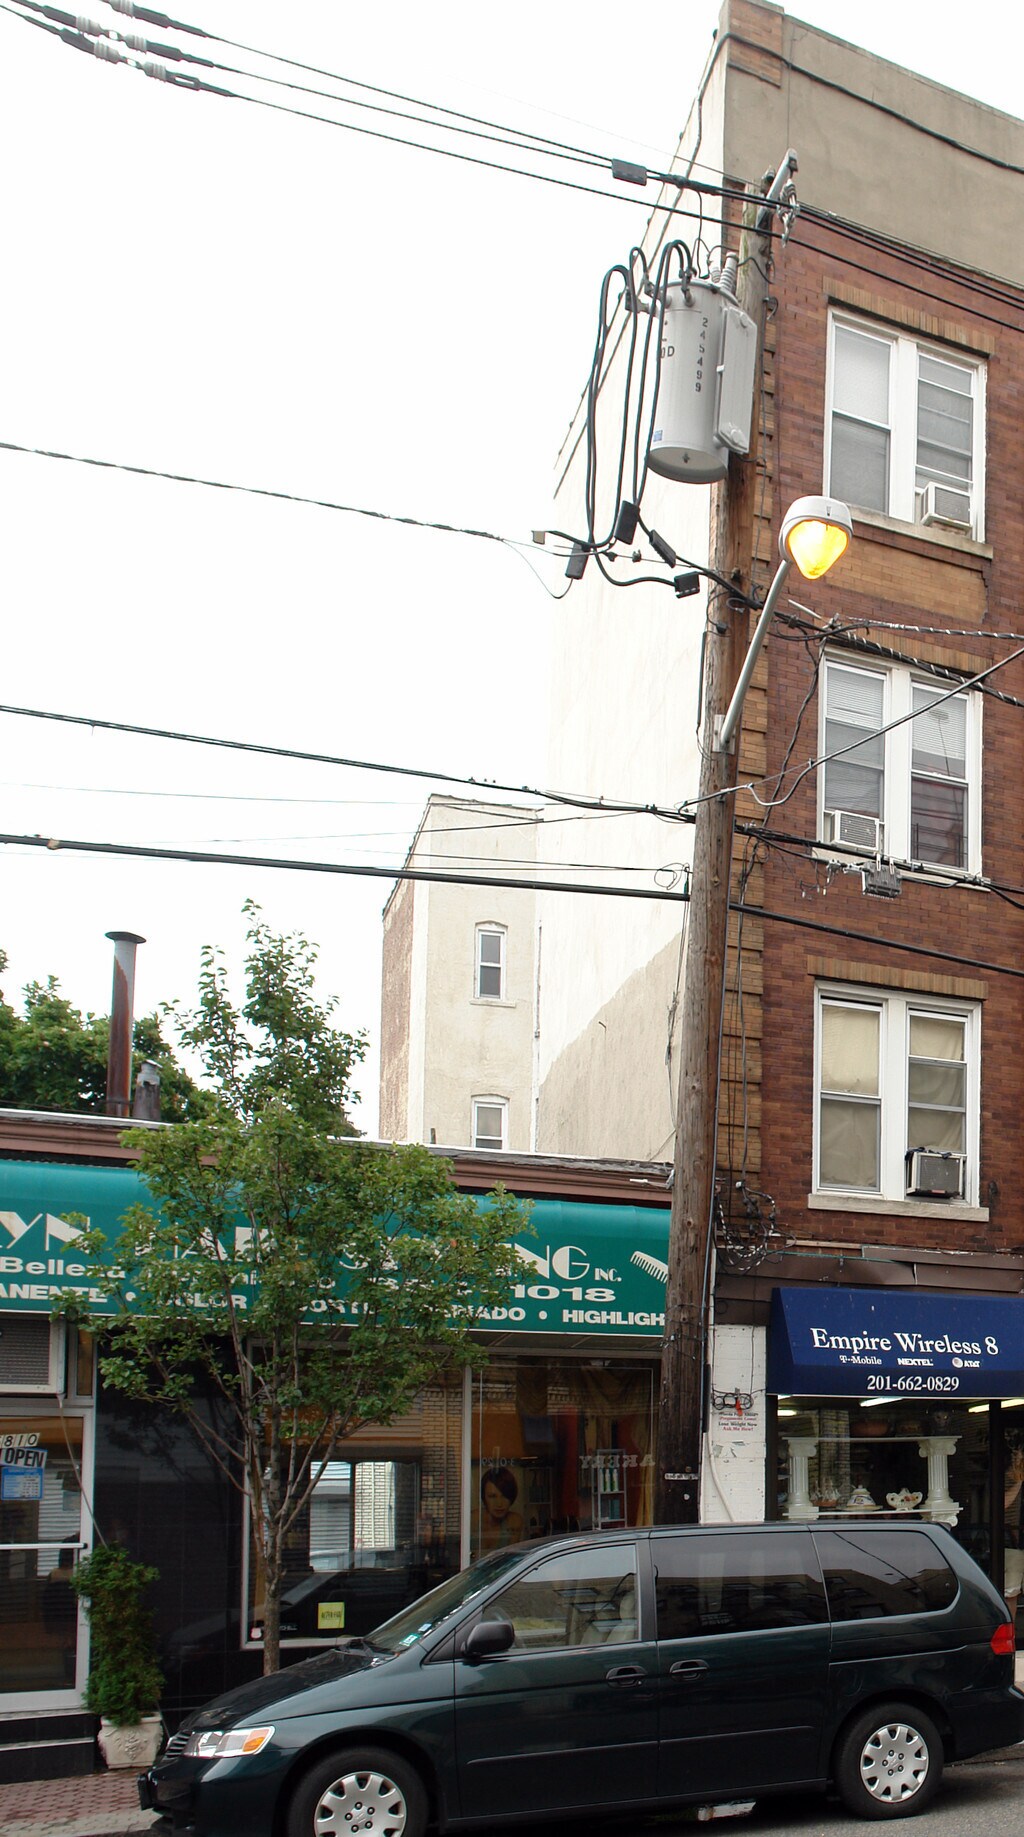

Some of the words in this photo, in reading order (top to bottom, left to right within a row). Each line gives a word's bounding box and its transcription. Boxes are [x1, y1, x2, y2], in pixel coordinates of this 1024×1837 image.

[810, 1327, 892, 1353] Empire
[893, 1331, 982, 1354] Wireless
[984, 1336, 999, 1355] 8
[897, 1357, 934, 1366] NEXTEL
[867, 1375, 960, 1391] 201-662-0829
[5, 1448, 44, 1467] OPEN
